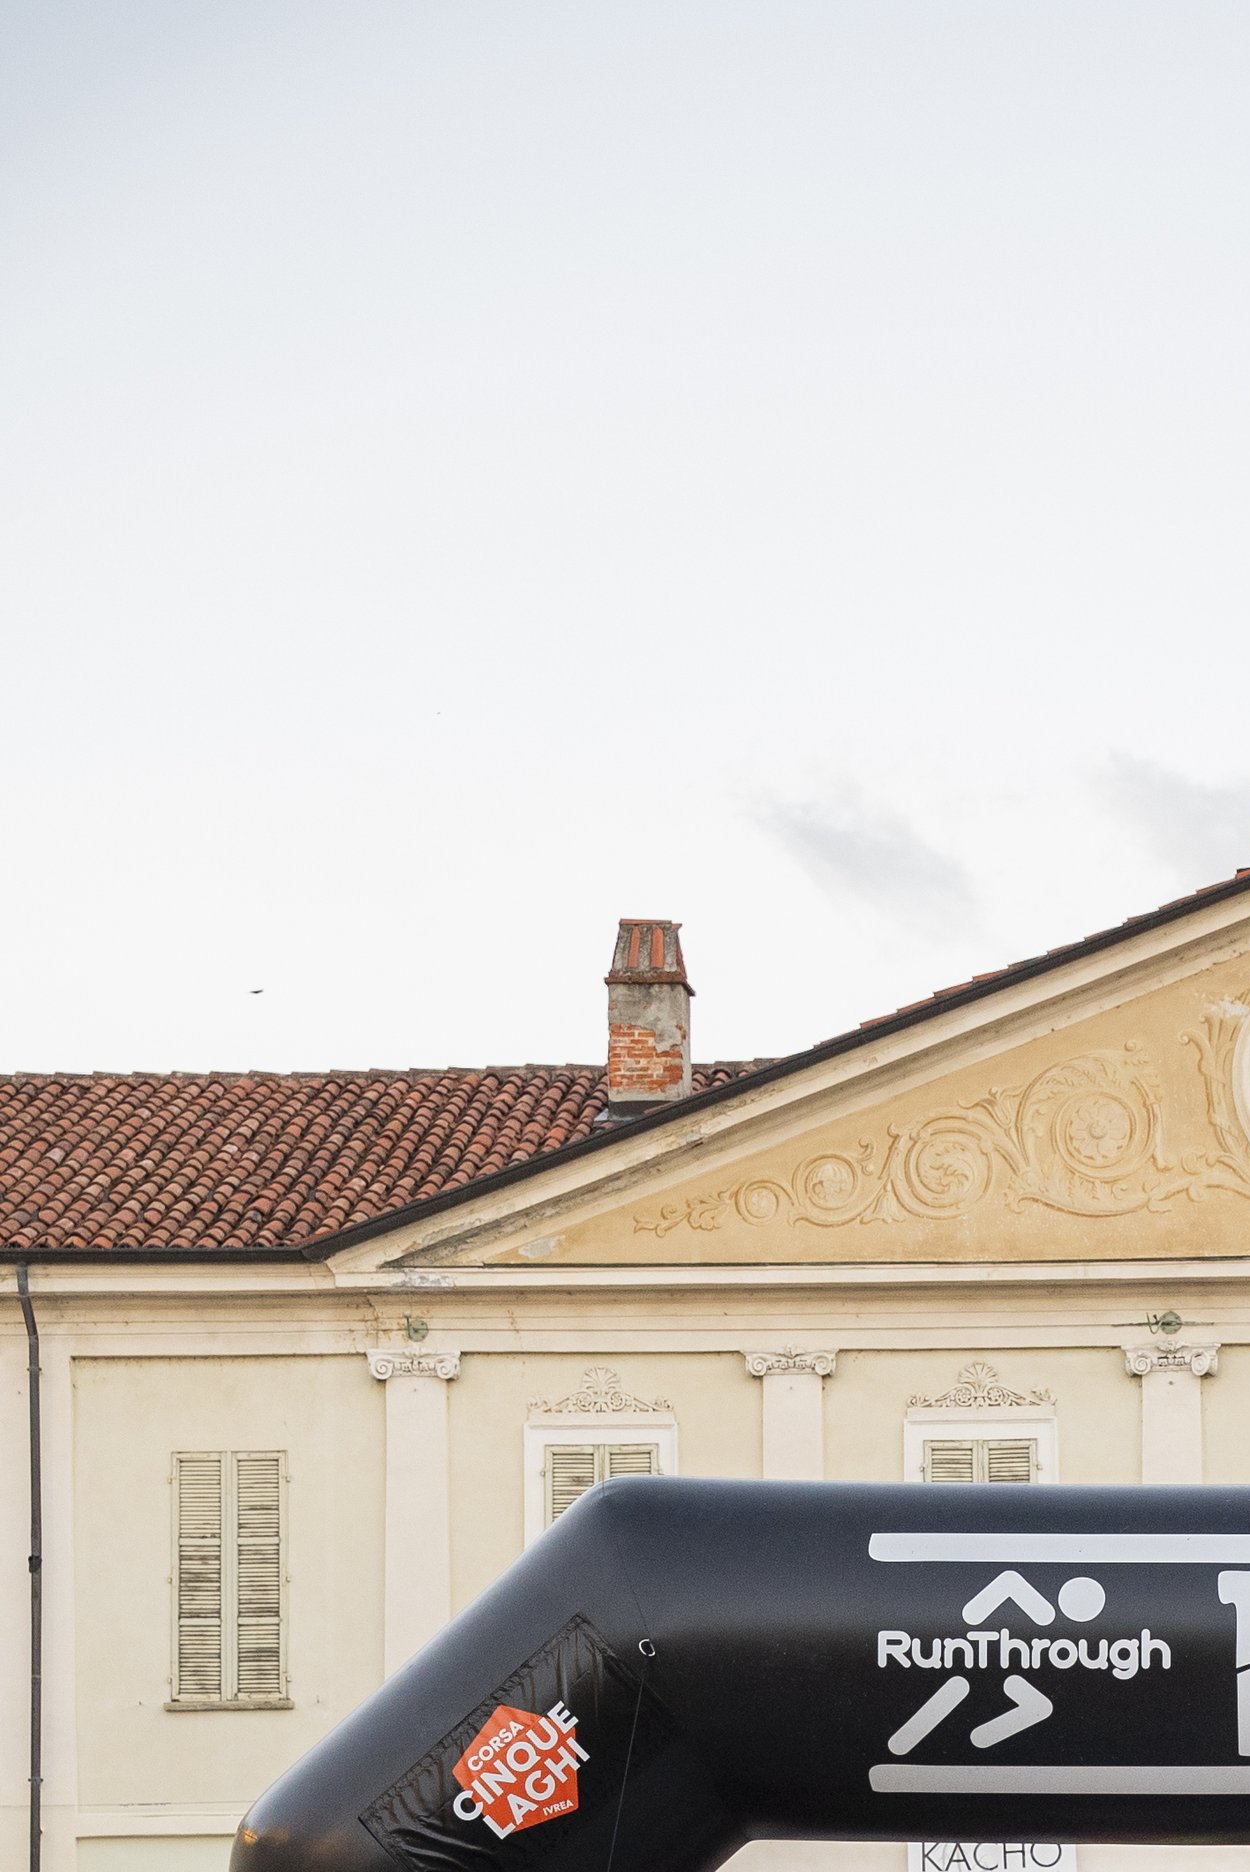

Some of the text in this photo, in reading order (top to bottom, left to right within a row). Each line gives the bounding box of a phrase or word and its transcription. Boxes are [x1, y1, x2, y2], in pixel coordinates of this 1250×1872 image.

[878, 1628, 1171, 1680] RunThrough
[453, 1700, 579, 1821] CINQUE
[467, 1721, 525, 1772] CORSA
[482, 1737, 590, 1840] LAGHI
[543, 1799, 574, 1816] IVREA
